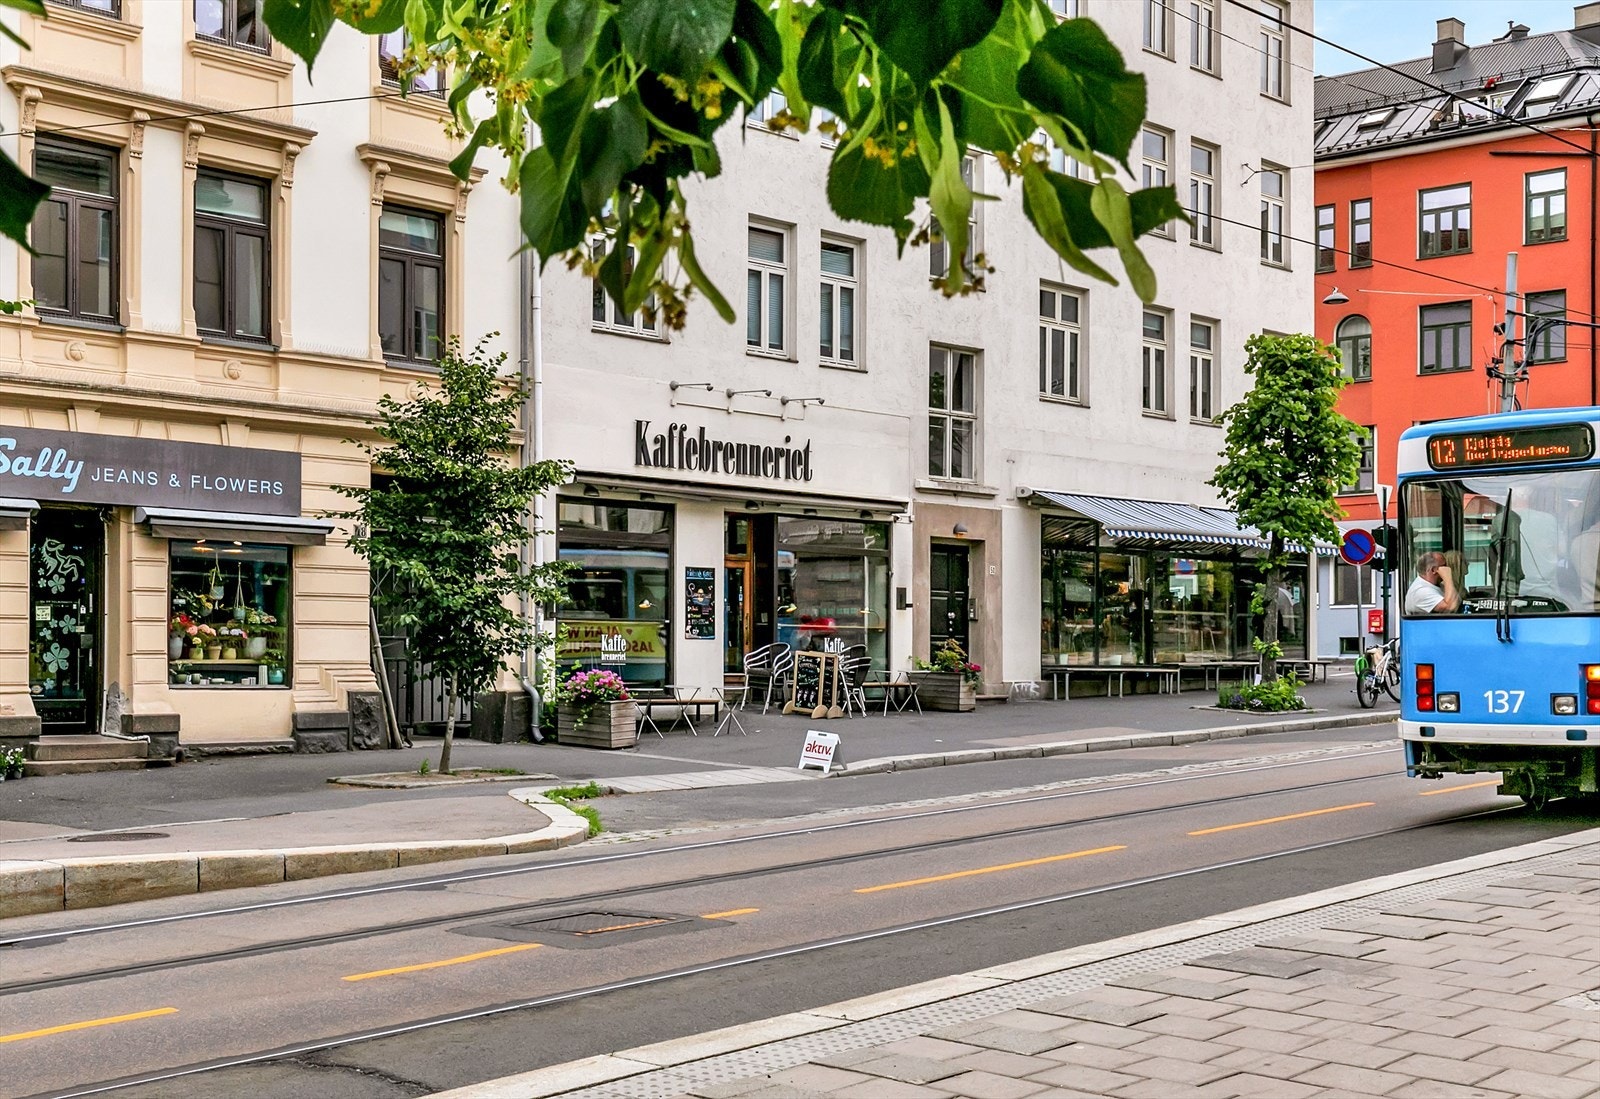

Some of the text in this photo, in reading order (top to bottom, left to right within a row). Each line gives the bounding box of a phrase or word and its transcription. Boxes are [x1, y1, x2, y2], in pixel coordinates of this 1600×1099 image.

[634, 419, 813, 481] Kaffebrenneriet
[1432, 440, 1456, 464] 12
[0, 438, 284, 495] Sally JEANS & FLOWERS
[601, 634, 627, 651] Kaffe
[824, 637, 845, 653] Kaffe
[1483, 690, 1525, 714] 137
[805, 740, 832, 756] aktiv.
